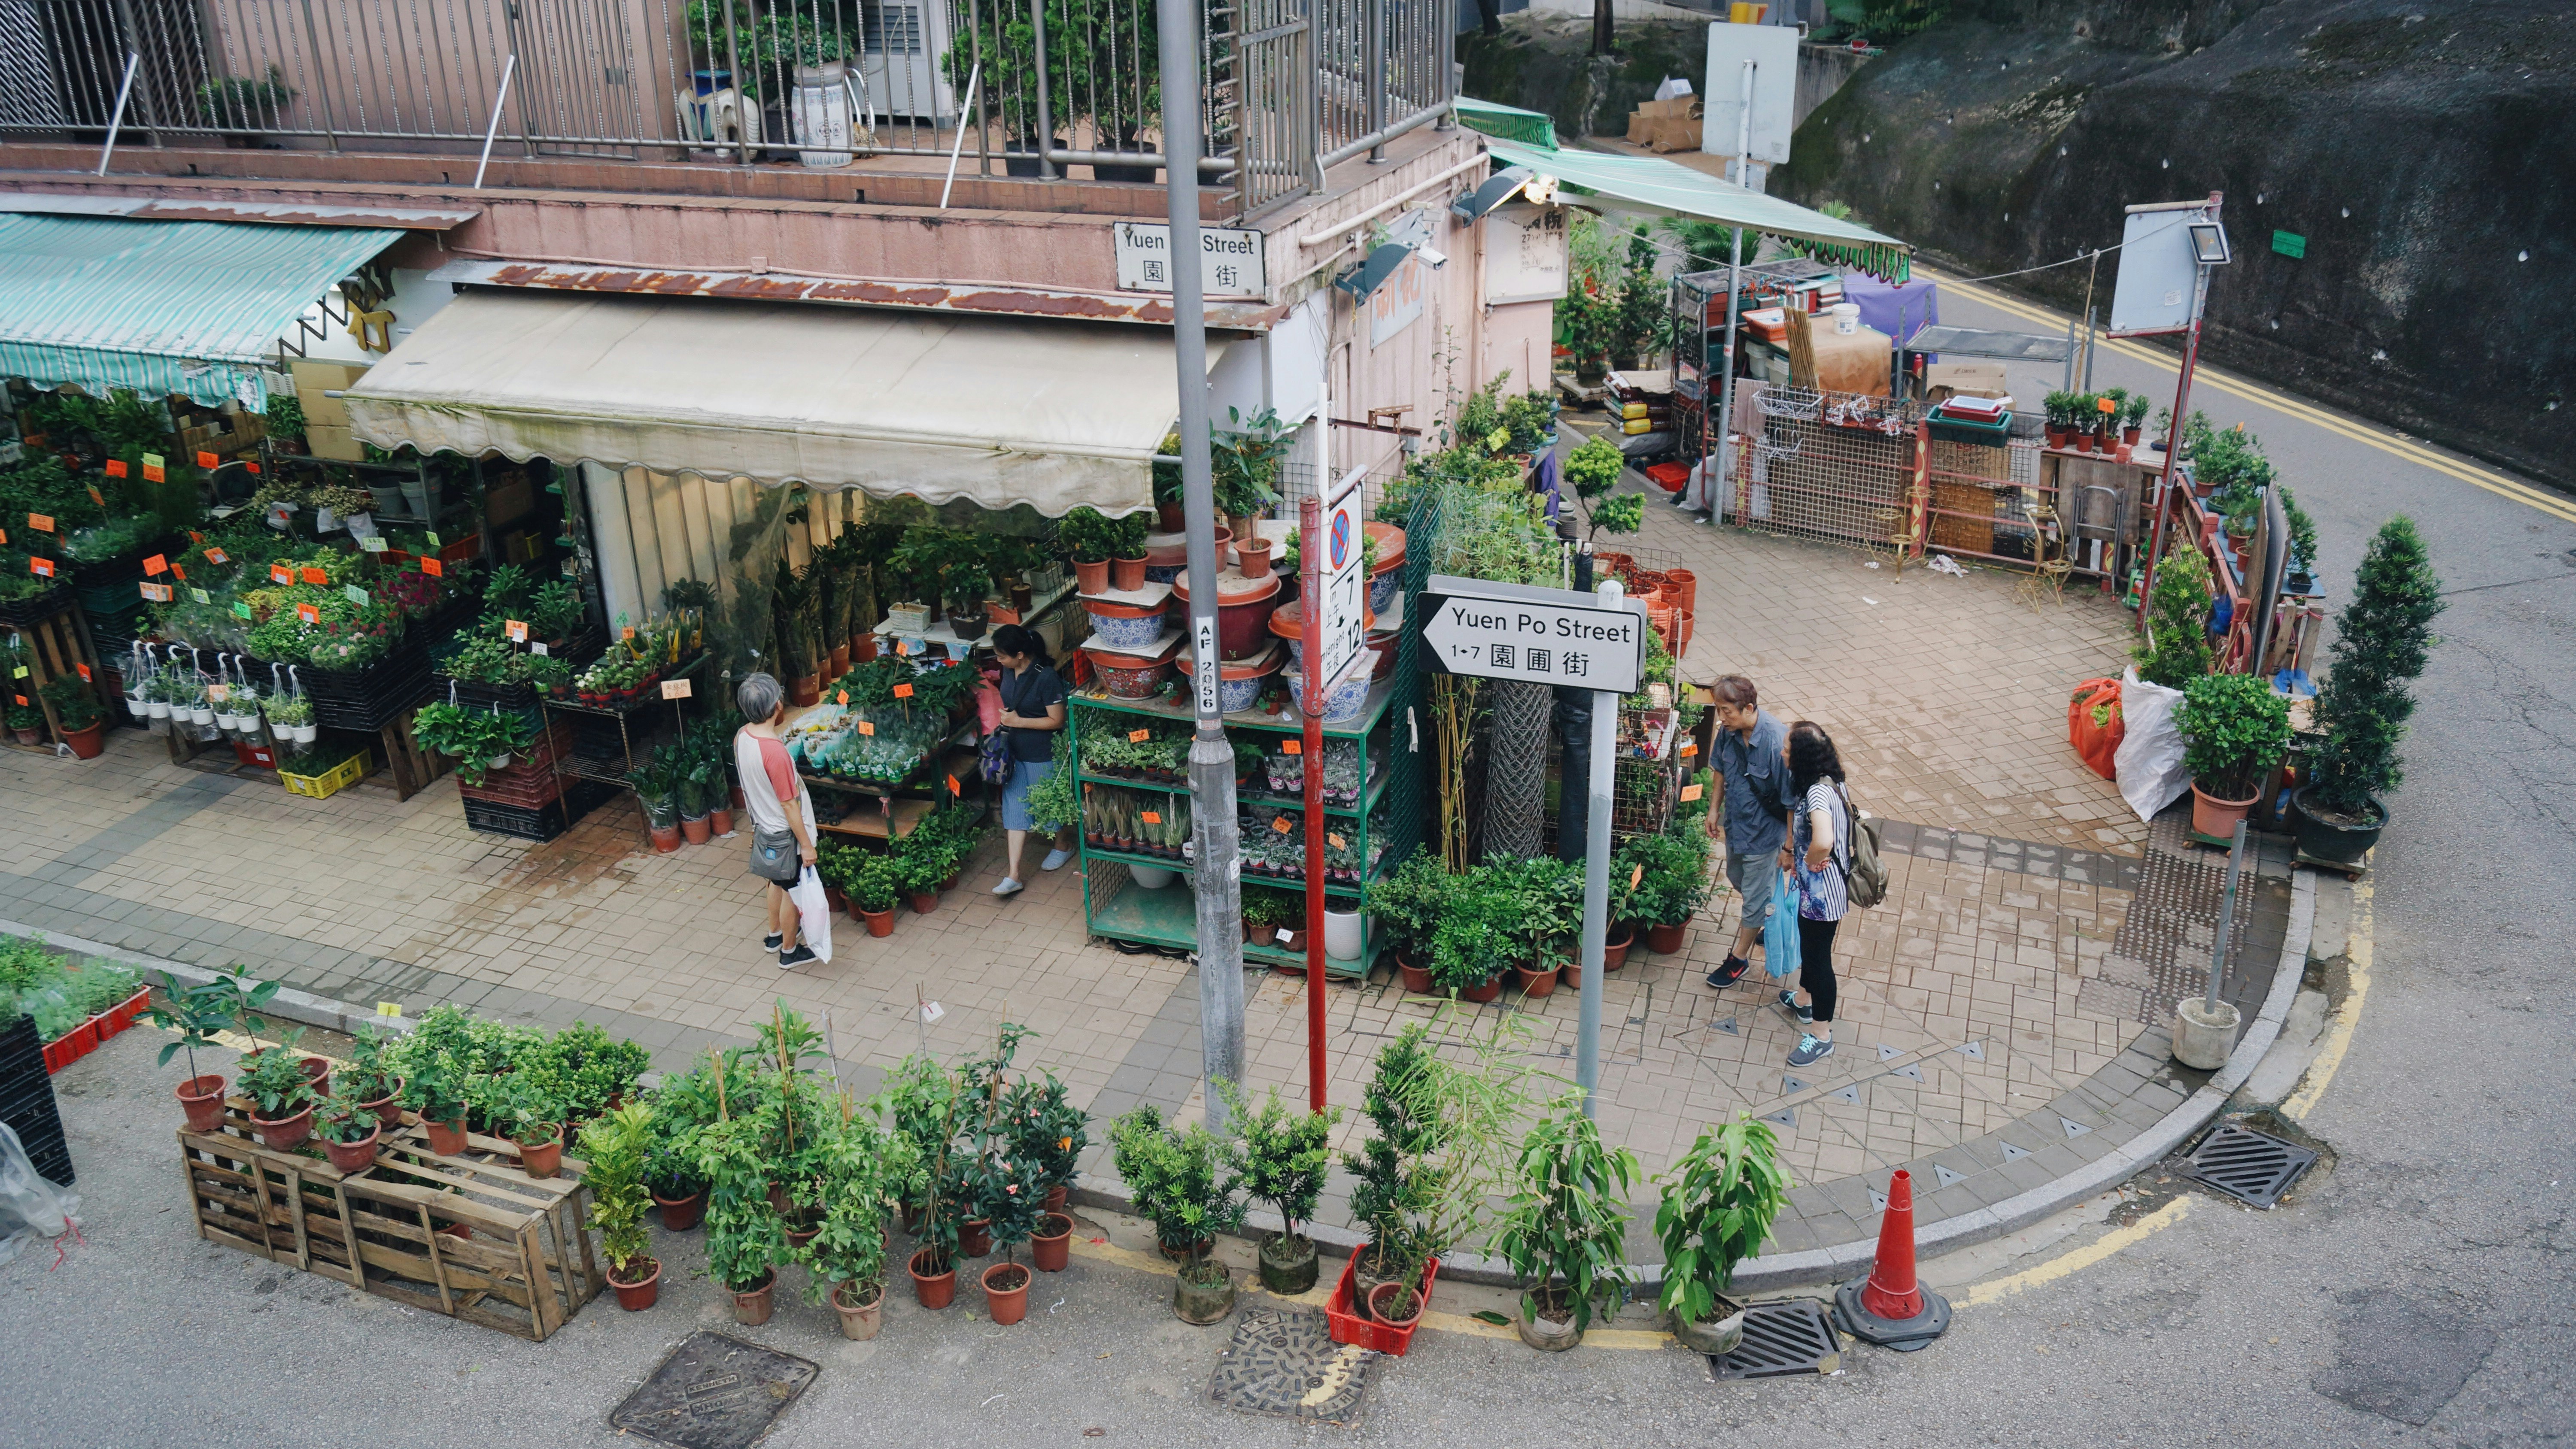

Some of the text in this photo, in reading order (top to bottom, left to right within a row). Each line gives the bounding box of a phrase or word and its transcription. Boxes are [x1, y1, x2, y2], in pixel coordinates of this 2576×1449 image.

[1124, 230, 1254, 254] Yuen Street
[1347, 573, 1353, 606] 7
[1326, 603, 1339, 628] 上午
[1452, 607, 1630, 643] Yuen Po Street
[1321, 630, 1344, 663] midnight
[1348, 618, 1360, 654] 12
[1326, 652, 1339, 676] 午夜
[1491, 644, 1589, 676] 園圃街
[689, 1376, 736, 1392] KENNETH
